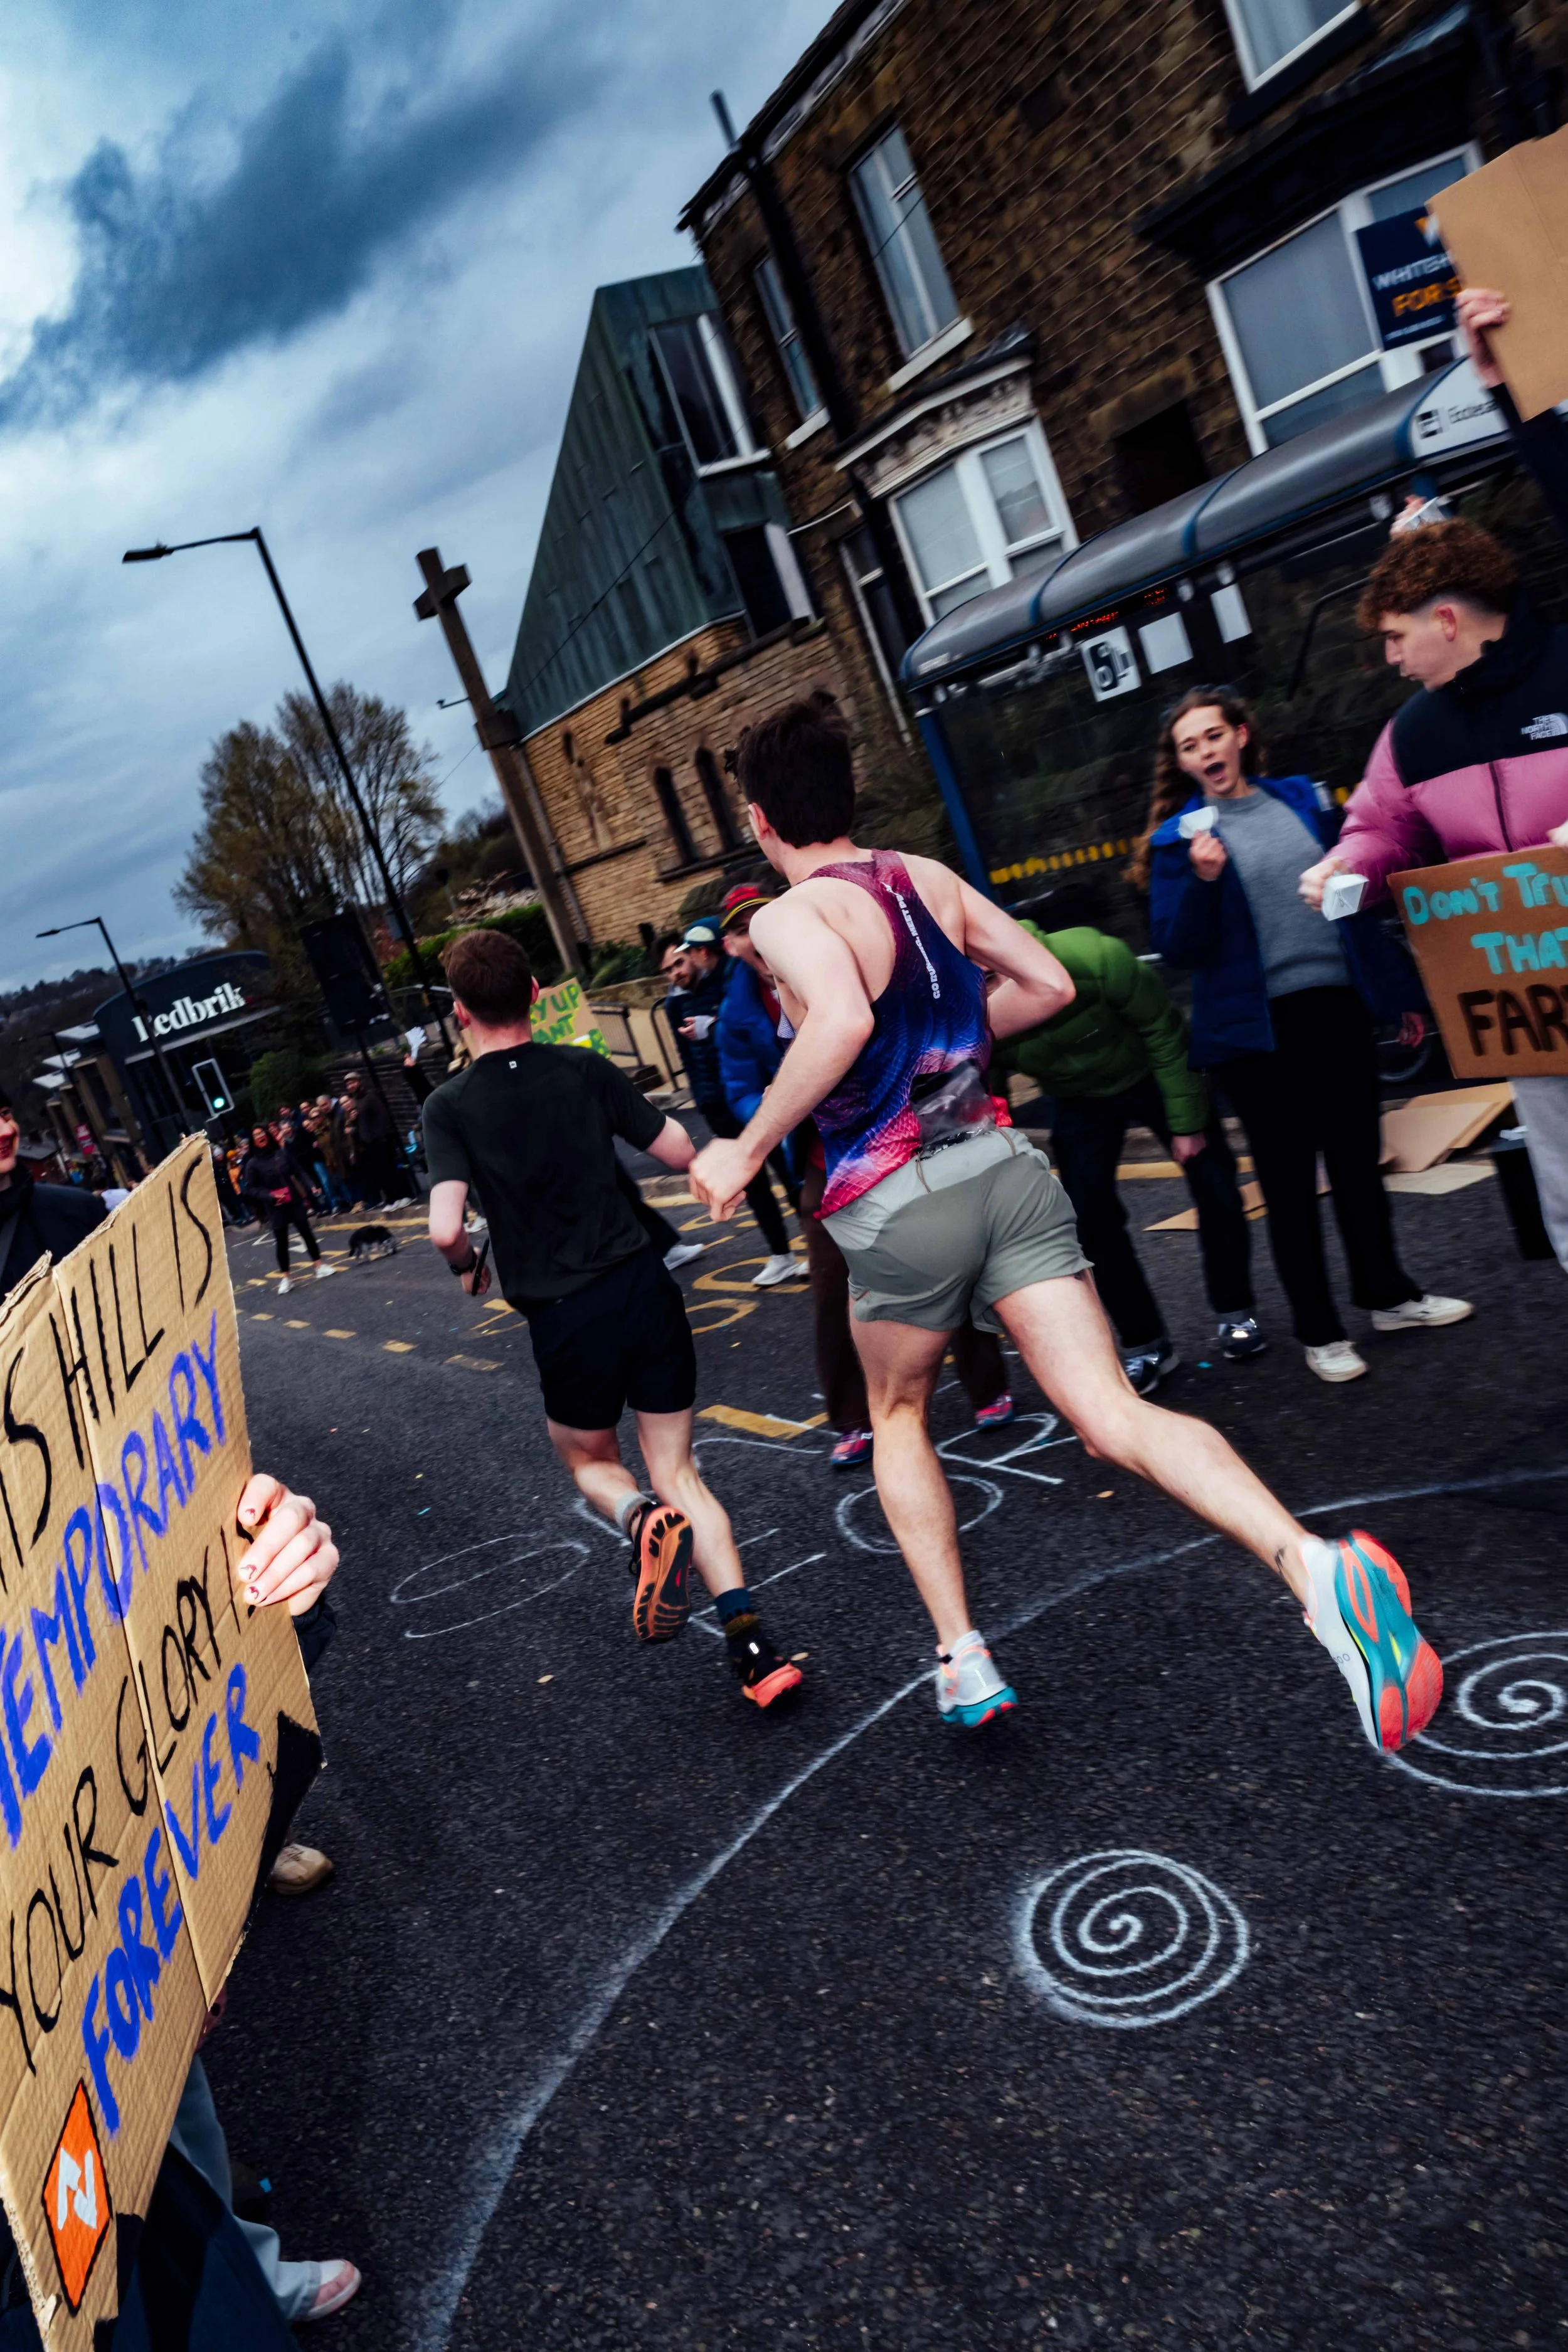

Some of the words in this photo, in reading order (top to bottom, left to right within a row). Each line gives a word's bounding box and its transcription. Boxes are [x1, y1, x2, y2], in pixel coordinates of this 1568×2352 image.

[1391, 282, 1442, 317] FOR
[1520, 722, 1552, 735] NORTH
[1531, 729, 1552, 740] FACE
[1532, 714, 1550, 725] THE
[550, 983, 581, 1014] UP
[931, 982, 941, 999] GO
[532, 1013, 576, 1044] ANT
[1456, 983, 1568, 1057] FAR
[0, 1346, 52, 1594] IS
[48, 1222, 165, 1471] HILL
[167, 1152, 213, 1315] IS
[0, 1765, 119, 2078] YOUR
[117, 1545, 221, 1816] GLORY
[82, 1662, 261, 2139] FOREVER
